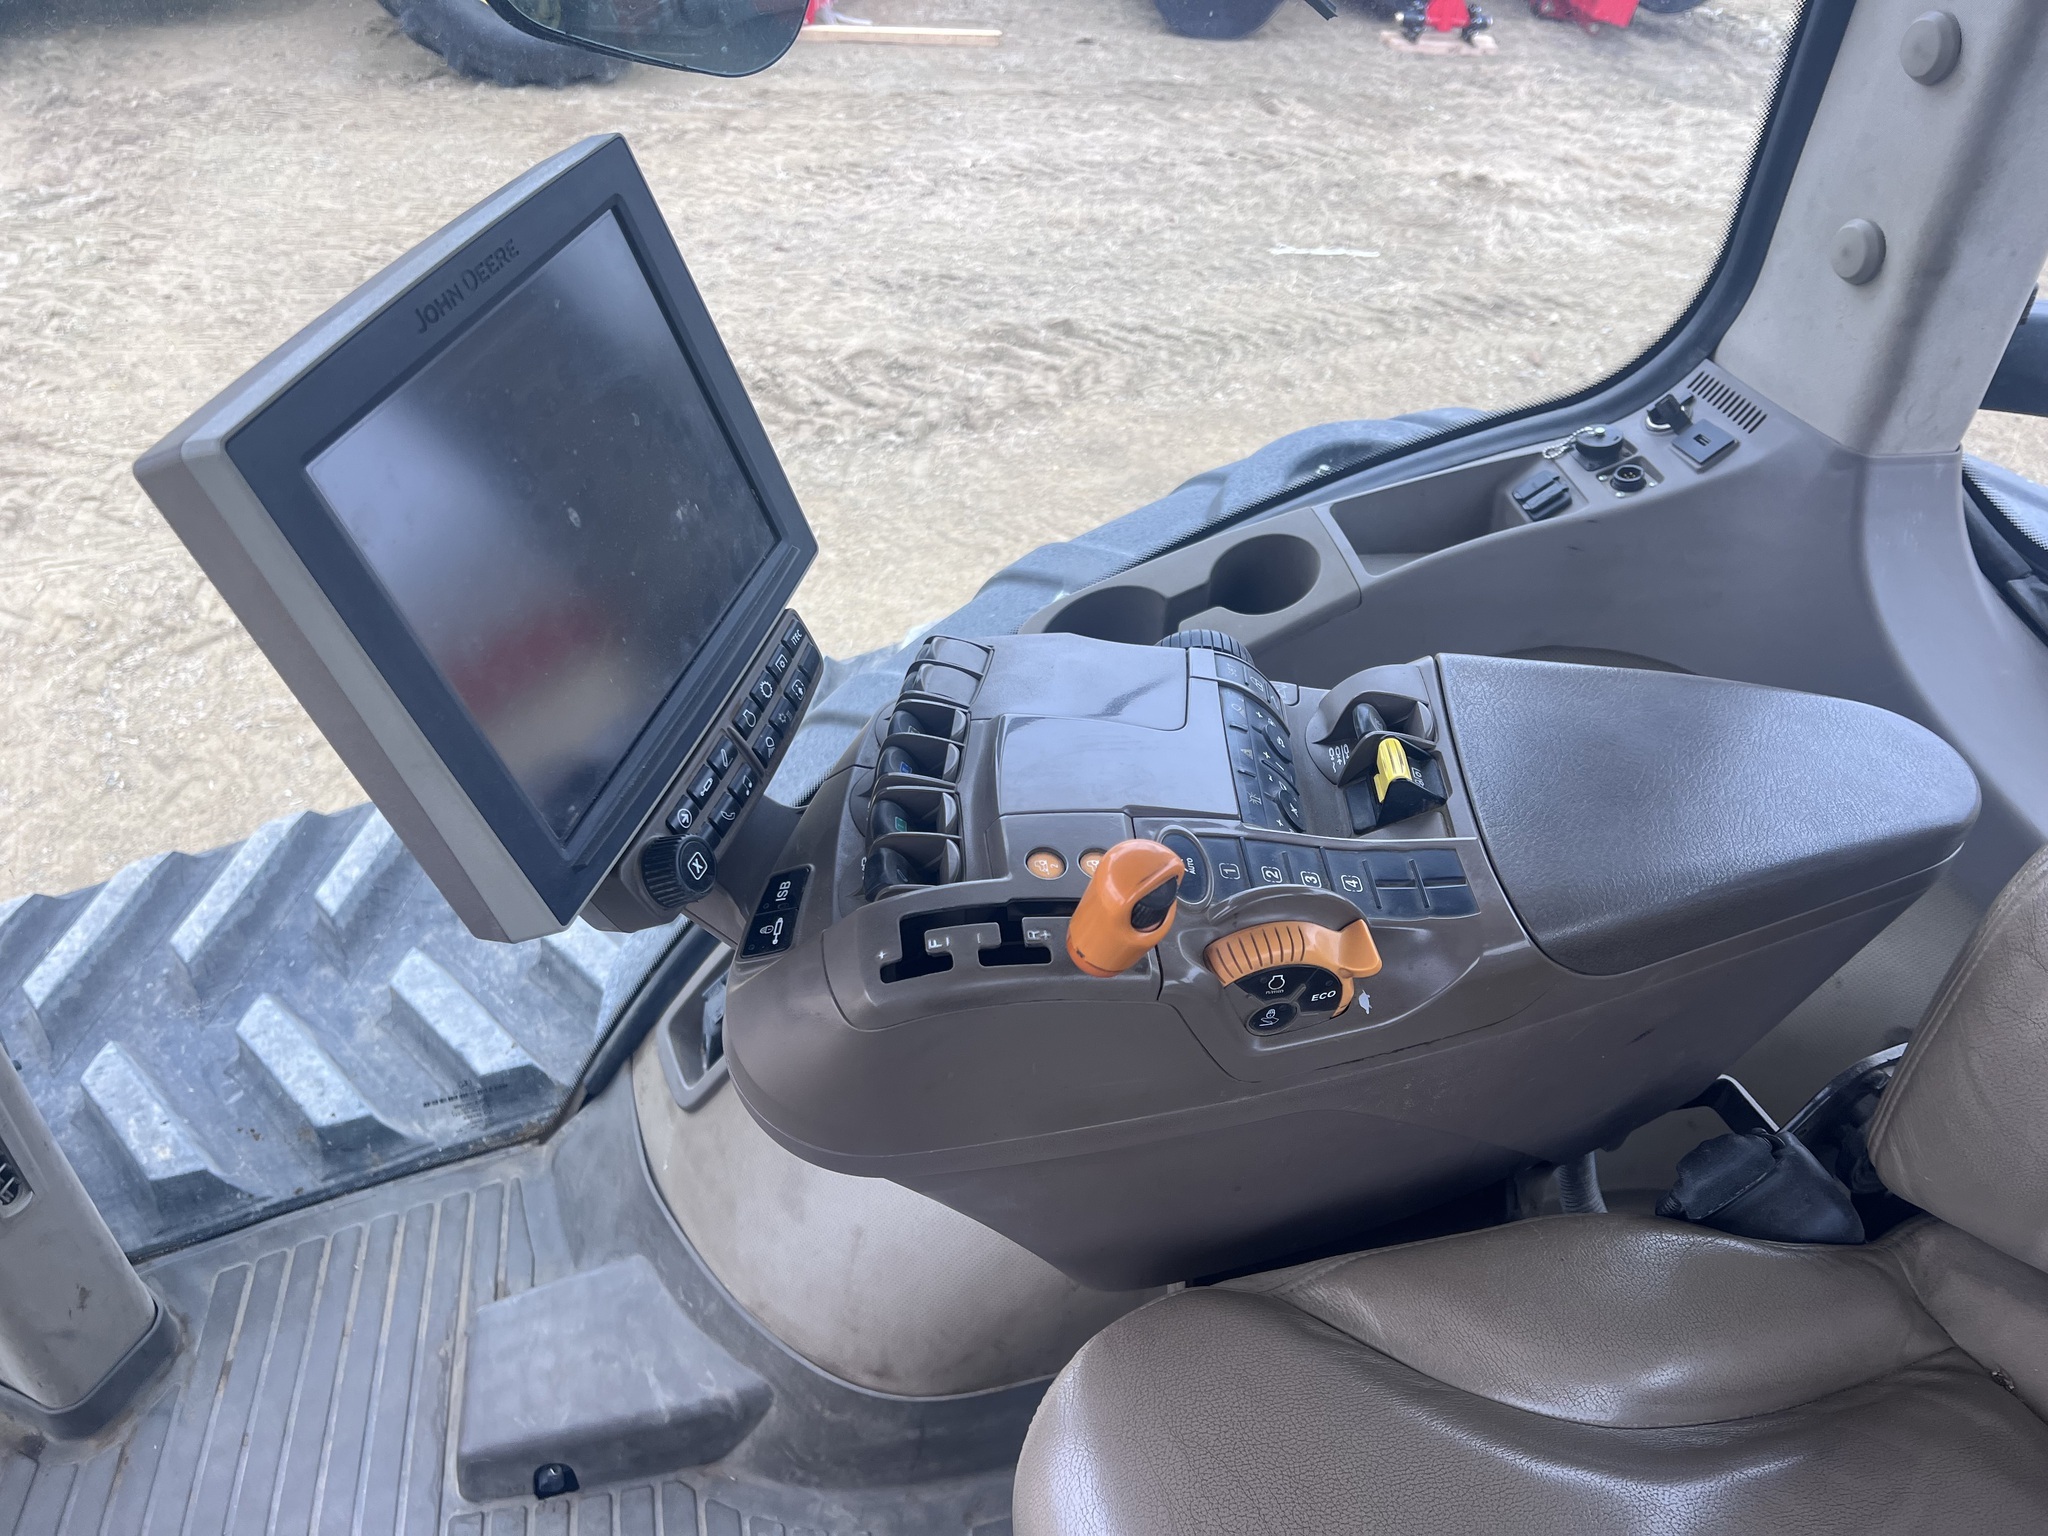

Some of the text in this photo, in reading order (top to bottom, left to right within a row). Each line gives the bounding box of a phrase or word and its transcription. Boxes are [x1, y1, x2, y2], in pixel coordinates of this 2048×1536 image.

[415, 238, 520, 334] JOHN DEERE
[790, 629, 803, 646] ITEC
[1186, 857, 1196, 875] AUTO
[1265, 870, 1279, 879] 2
[1305, 875, 1317, 884] 3
[1345, 880, 1358, 888] 4
[775, 881, 791, 902] ISB
[1027, 930, 1039, 939] R
[1311, 990, 1336, 1002] ECO
